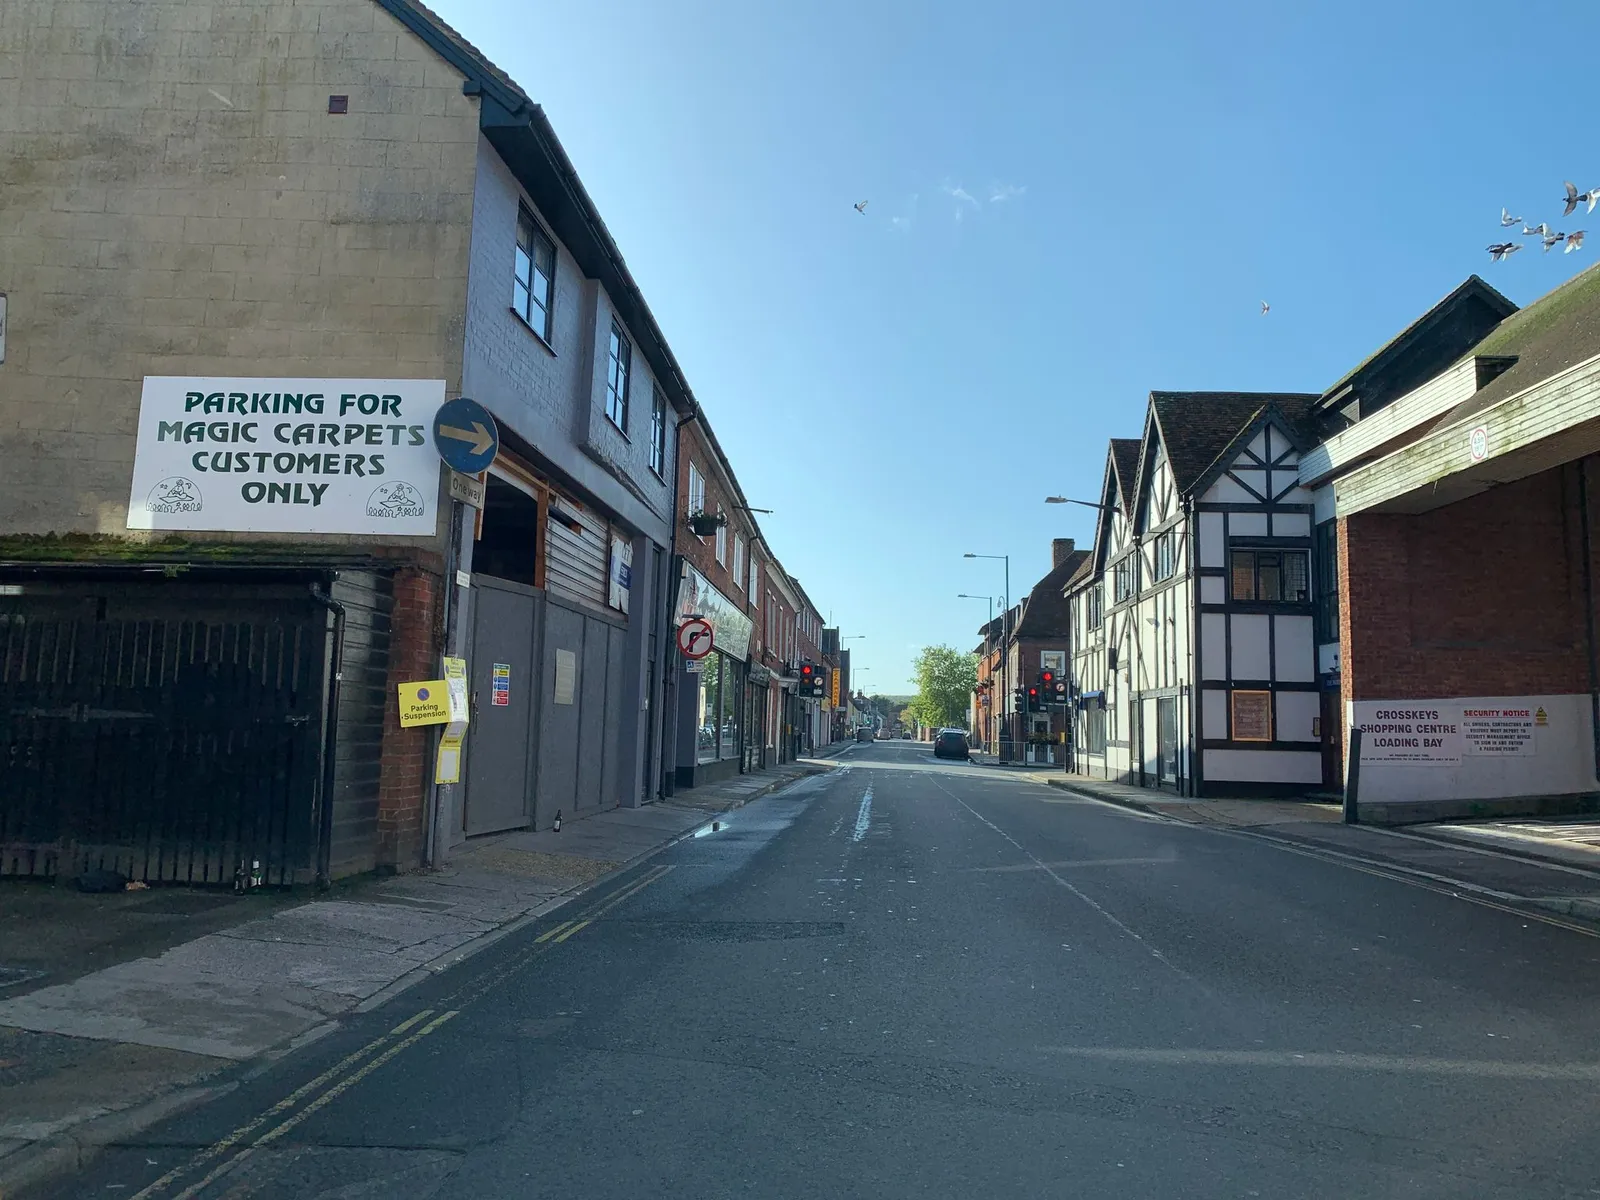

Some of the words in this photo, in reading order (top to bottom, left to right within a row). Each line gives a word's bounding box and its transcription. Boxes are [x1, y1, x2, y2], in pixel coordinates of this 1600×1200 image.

[185, 392, 324, 416] PARKING
[340, 394, 402, 418] FOR
[157, 420, 258, 444] MAGIC
[274, 423, 425, 448] CARPETS
[192, 452, 385, 478] CUSTOMERS
[242, 482, 330, 507] ONLY
[410, 704, 438, 712] Parking
[404, 710, 446, 720] Suspension
[1376, 710, 1439, 720] CROSSKEYS
[1360, 724, 1412, 733] SHOPPING
[1416, 725, 1456, 734] CENTRE
[1374, 738, 1419, 747] LOADING
[1424, 738, 1443, 747] BAY
